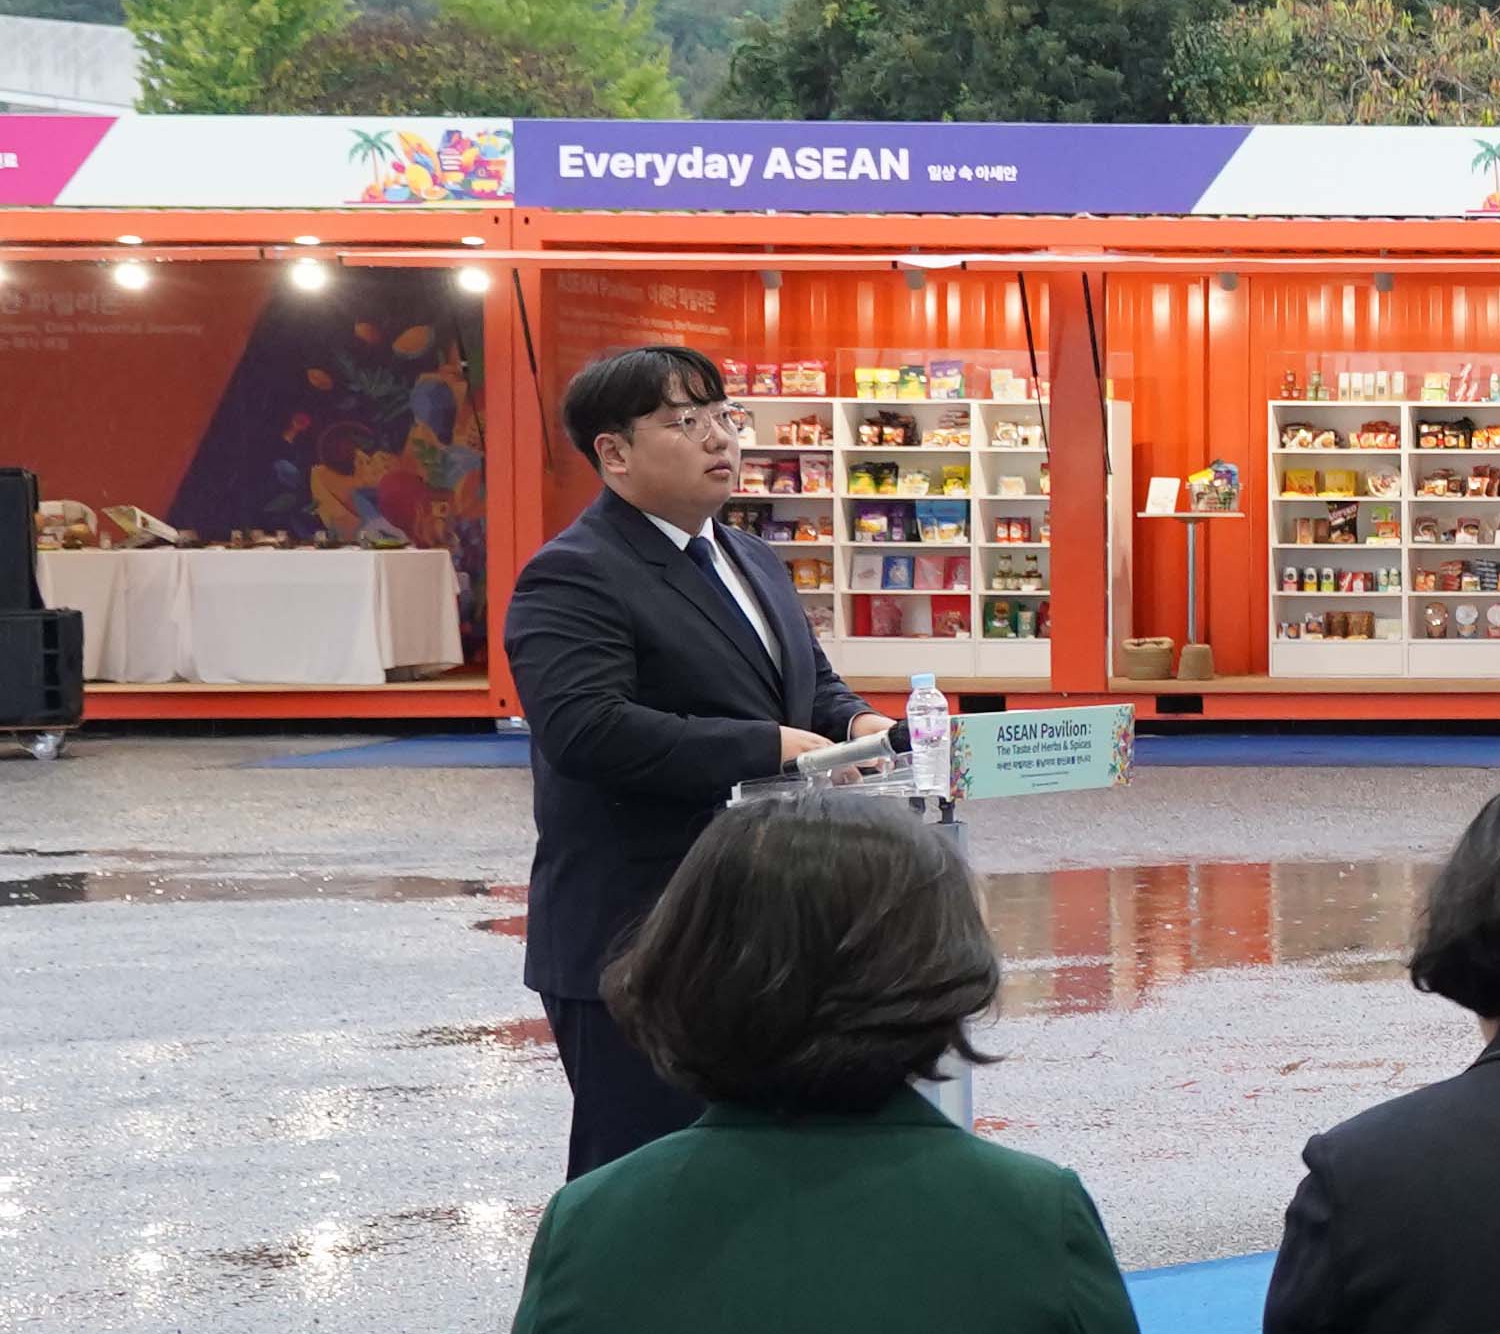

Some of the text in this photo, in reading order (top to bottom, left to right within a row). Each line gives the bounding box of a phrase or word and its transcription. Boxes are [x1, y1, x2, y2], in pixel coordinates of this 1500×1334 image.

[558, 144, 910, 187] Everyday ASEAN
[927, 164, 1018, 183] 일상 속 아세안
[997, 720, 1092, 742] ASEAN Pavilion:
[997, 738, 1092, 756] The Taste of Herbs & Spices
